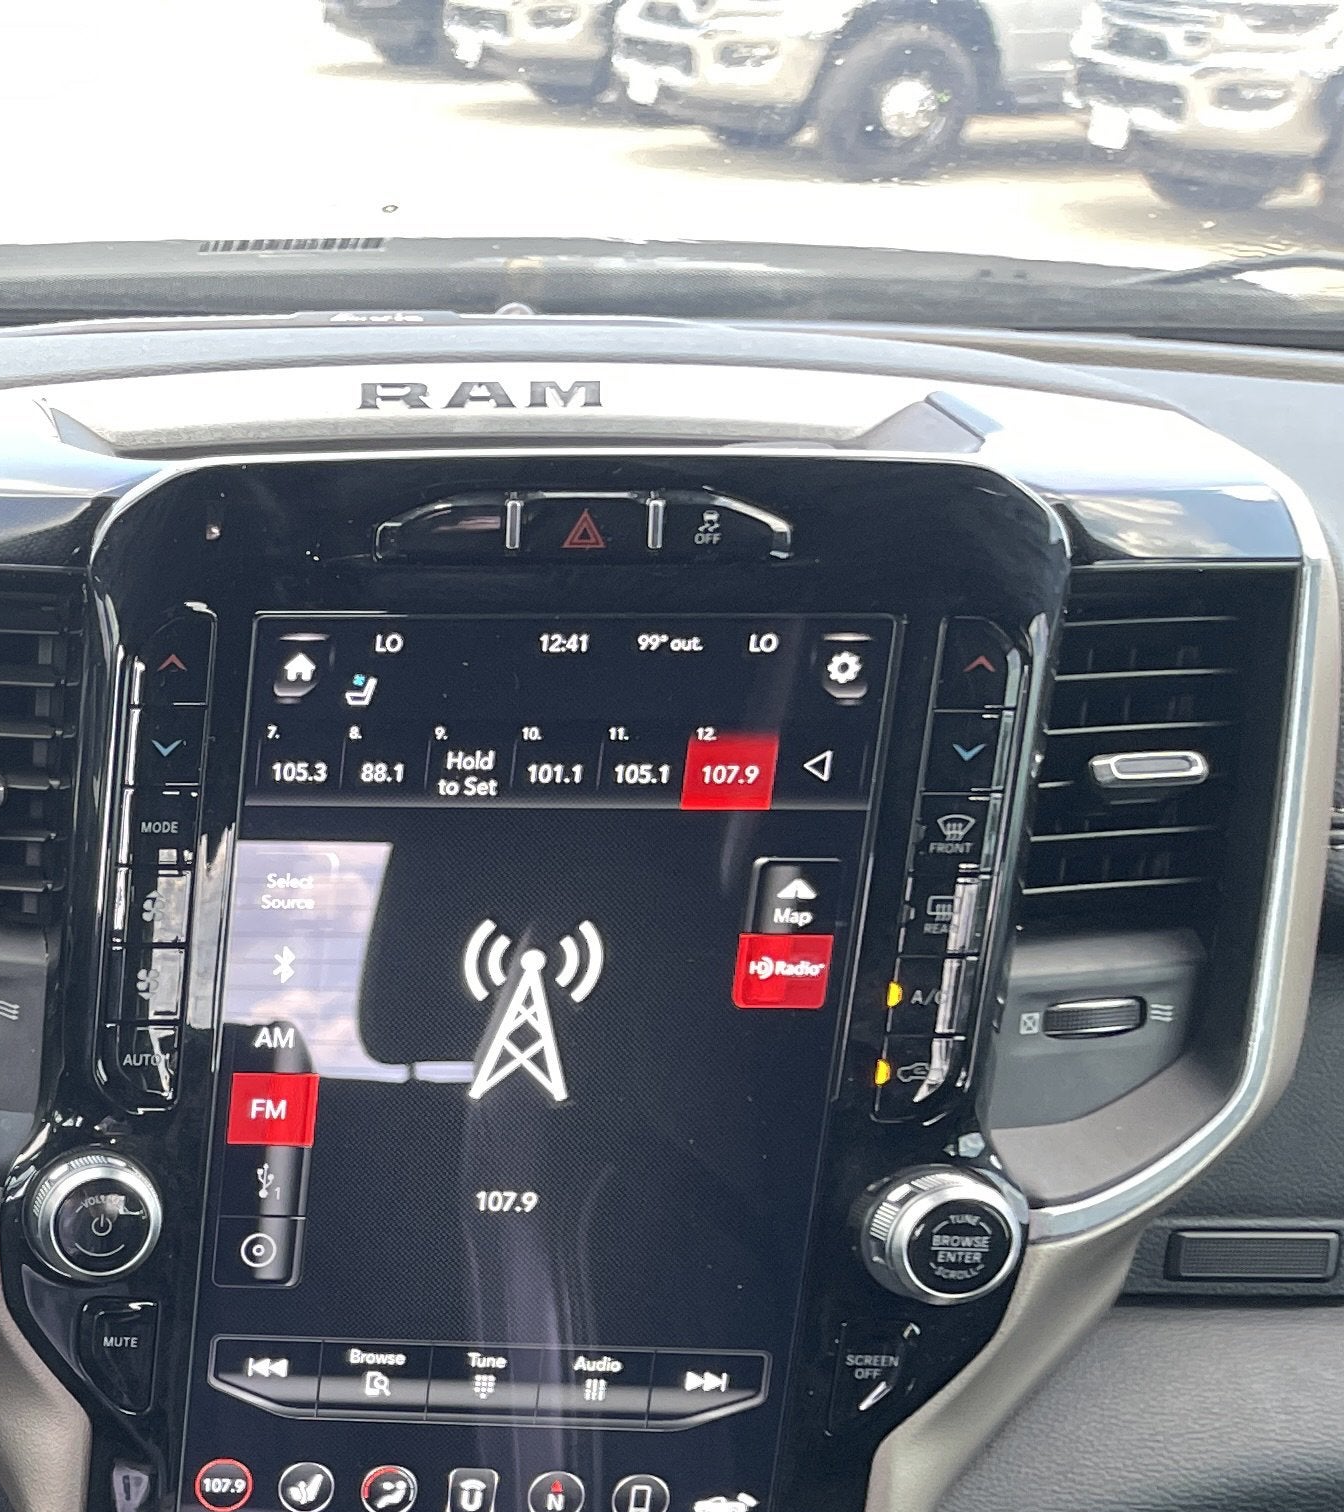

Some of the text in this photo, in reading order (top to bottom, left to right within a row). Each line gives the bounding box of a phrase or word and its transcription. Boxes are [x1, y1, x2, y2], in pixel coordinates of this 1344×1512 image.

[357, 381, 603, 410] RAM
[694, 532, 722, 545] OFF
[375, 634, 404, 653] LO
[539, 633, 590, 653] 12:41
[748, 634, 779, 653] LO
[445, 750, 496, 772] Hold
[271, 762, 328, 783] 105.3
[361, 763, 405, 783] 88.1
[527, 763, 584, 785] 101.1
[614, 764, 670, 785] 105.1
[702, 765, 760, 785] 107.9
[438, 776, 498, 797] to Set
[140, 821, 179, 834] MODE
[929, 842, 973, 854] FRONT
[266, 873, 314, 890] Select
[261, 894, 315, 910] Source
[773, 908, 812, 928] Map
[254, 1027, 295, 1049] AM
[250, 1099, 287, 1120] FM
[475, 1190, 539, 1212] 107.9
[949, 1214, 981, 1226] TUNE
[932, 1235, 991, 1247] BROWSE
[937, 1251, 982, 1263] ENTER
[934, 1266, 980, 1280] SCROLL
[103, 1336, 138, 1348] MUTE
[348, 1348, 406, 1366] Browse
[468, 1352, 508, 1369] Tune
[573, 1355, 623, 1373] Audio
[845, 1354, 899, 1367] SCREEN
[855, 1369, 882, 1380] OFF
[202, 1477, 247, 1493] 107.9
[547, 1494, 564, 1511] N
